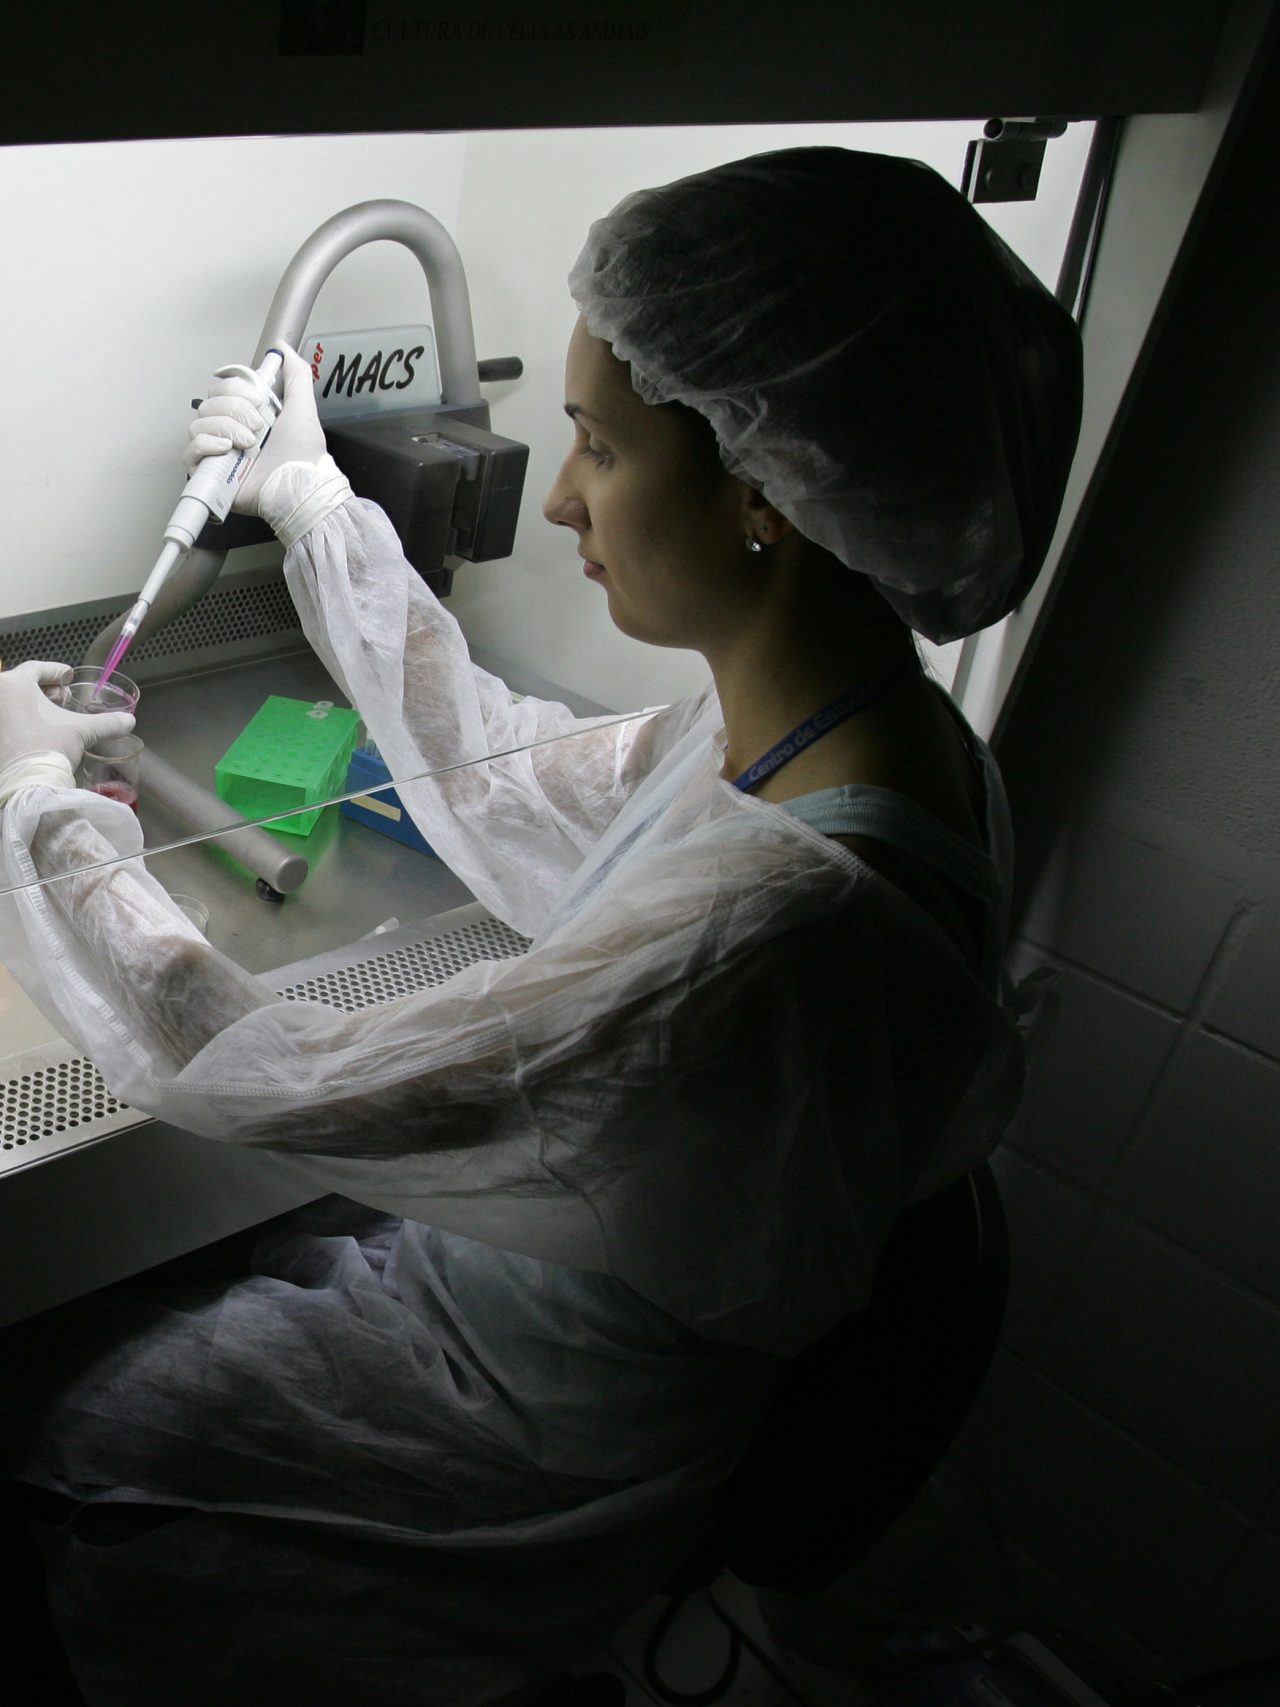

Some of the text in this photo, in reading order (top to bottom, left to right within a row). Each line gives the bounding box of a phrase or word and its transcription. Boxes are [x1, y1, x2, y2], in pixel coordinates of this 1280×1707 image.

[372, 18, 462, 41] CULTURA
[468, 19, 494, 41] DE
[577, 18, 652, 42] ANIMAIS
[322, 345, 425, 399] MACS
[748, 742, 795, 782] Centro
[794, 725, 817, 747] de
